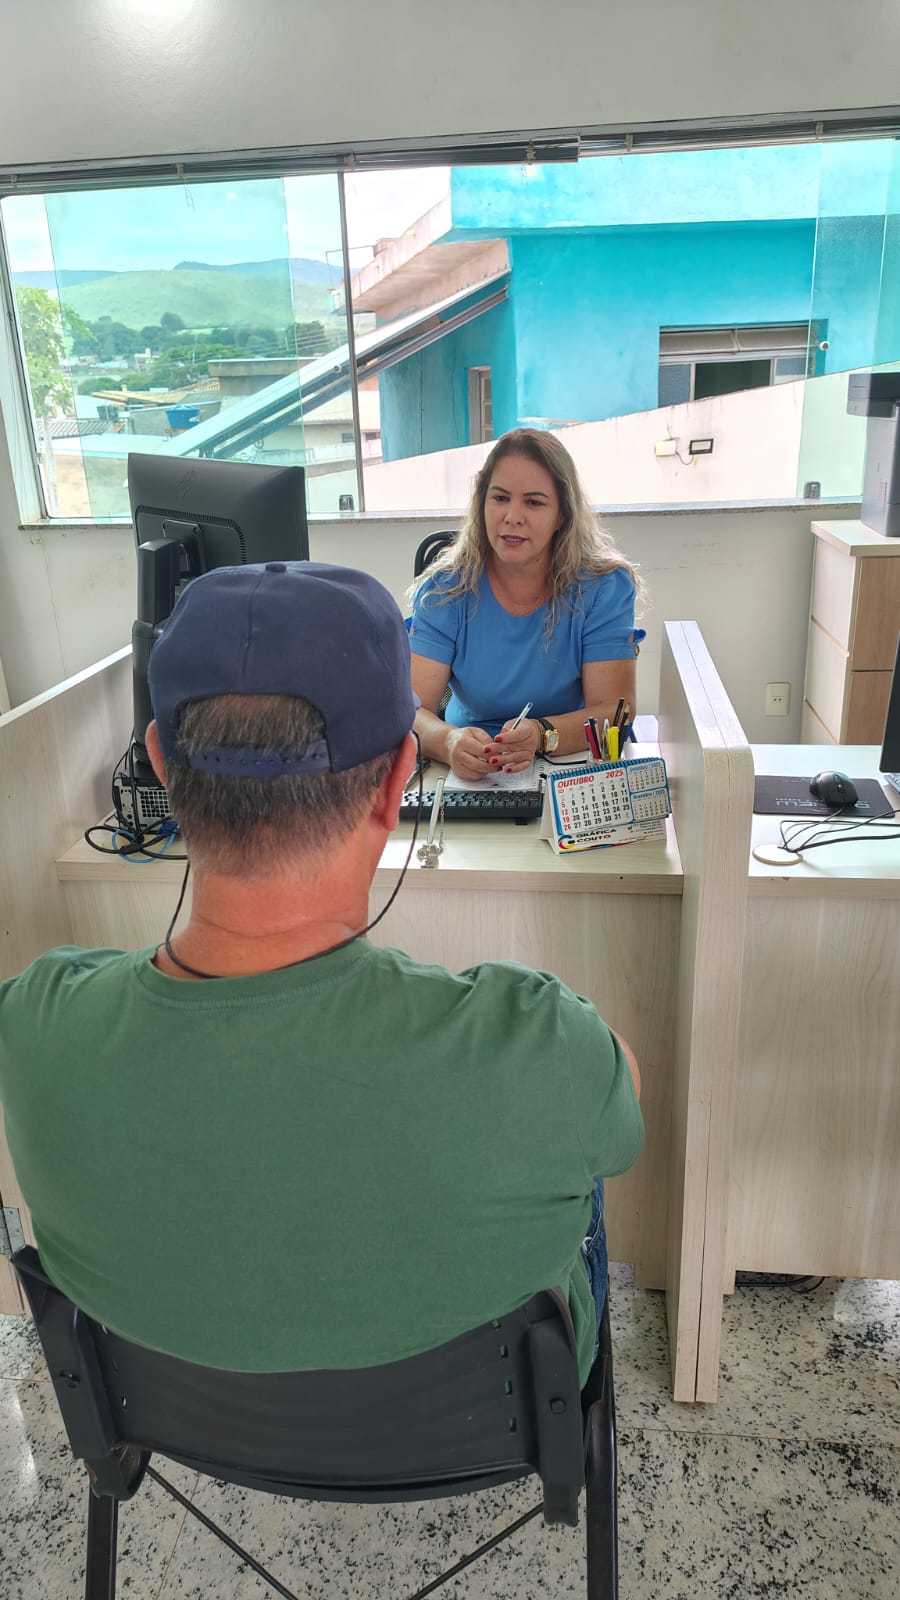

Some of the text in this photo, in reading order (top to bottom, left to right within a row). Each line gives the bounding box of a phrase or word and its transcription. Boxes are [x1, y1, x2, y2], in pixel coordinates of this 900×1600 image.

[557, 775, 595, 789] OUTUBRO
[605, 769, 624, 779] 2025
[594, 817, 602, 825] 29
[576, 835, 612, 843] COUTO
